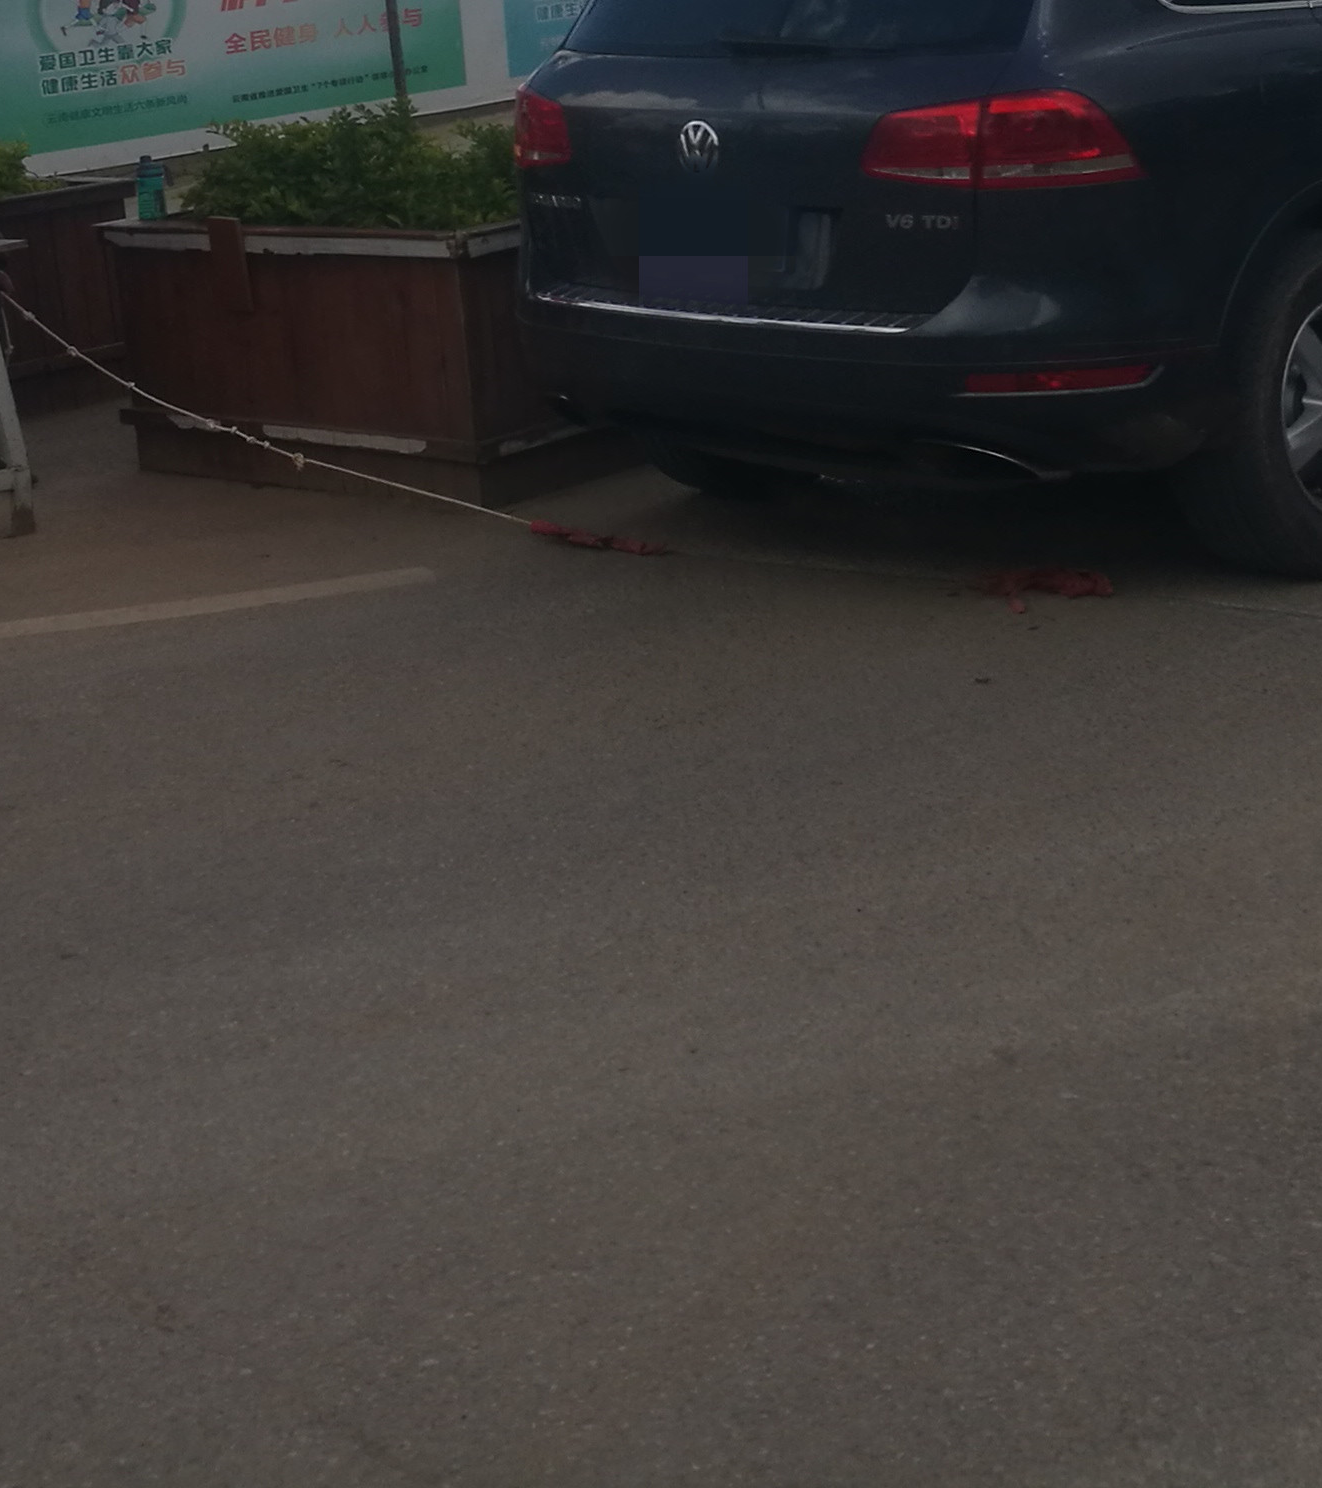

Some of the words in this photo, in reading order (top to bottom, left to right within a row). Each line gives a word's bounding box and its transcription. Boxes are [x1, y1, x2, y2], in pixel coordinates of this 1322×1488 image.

[38, 38, 174, 73] 爱国卫生靠大家
[223, 22, 319, 56] 全民健身
[40, 58, 187, 97] 健康生活众参与
[884, 213, 914, 230] V6
